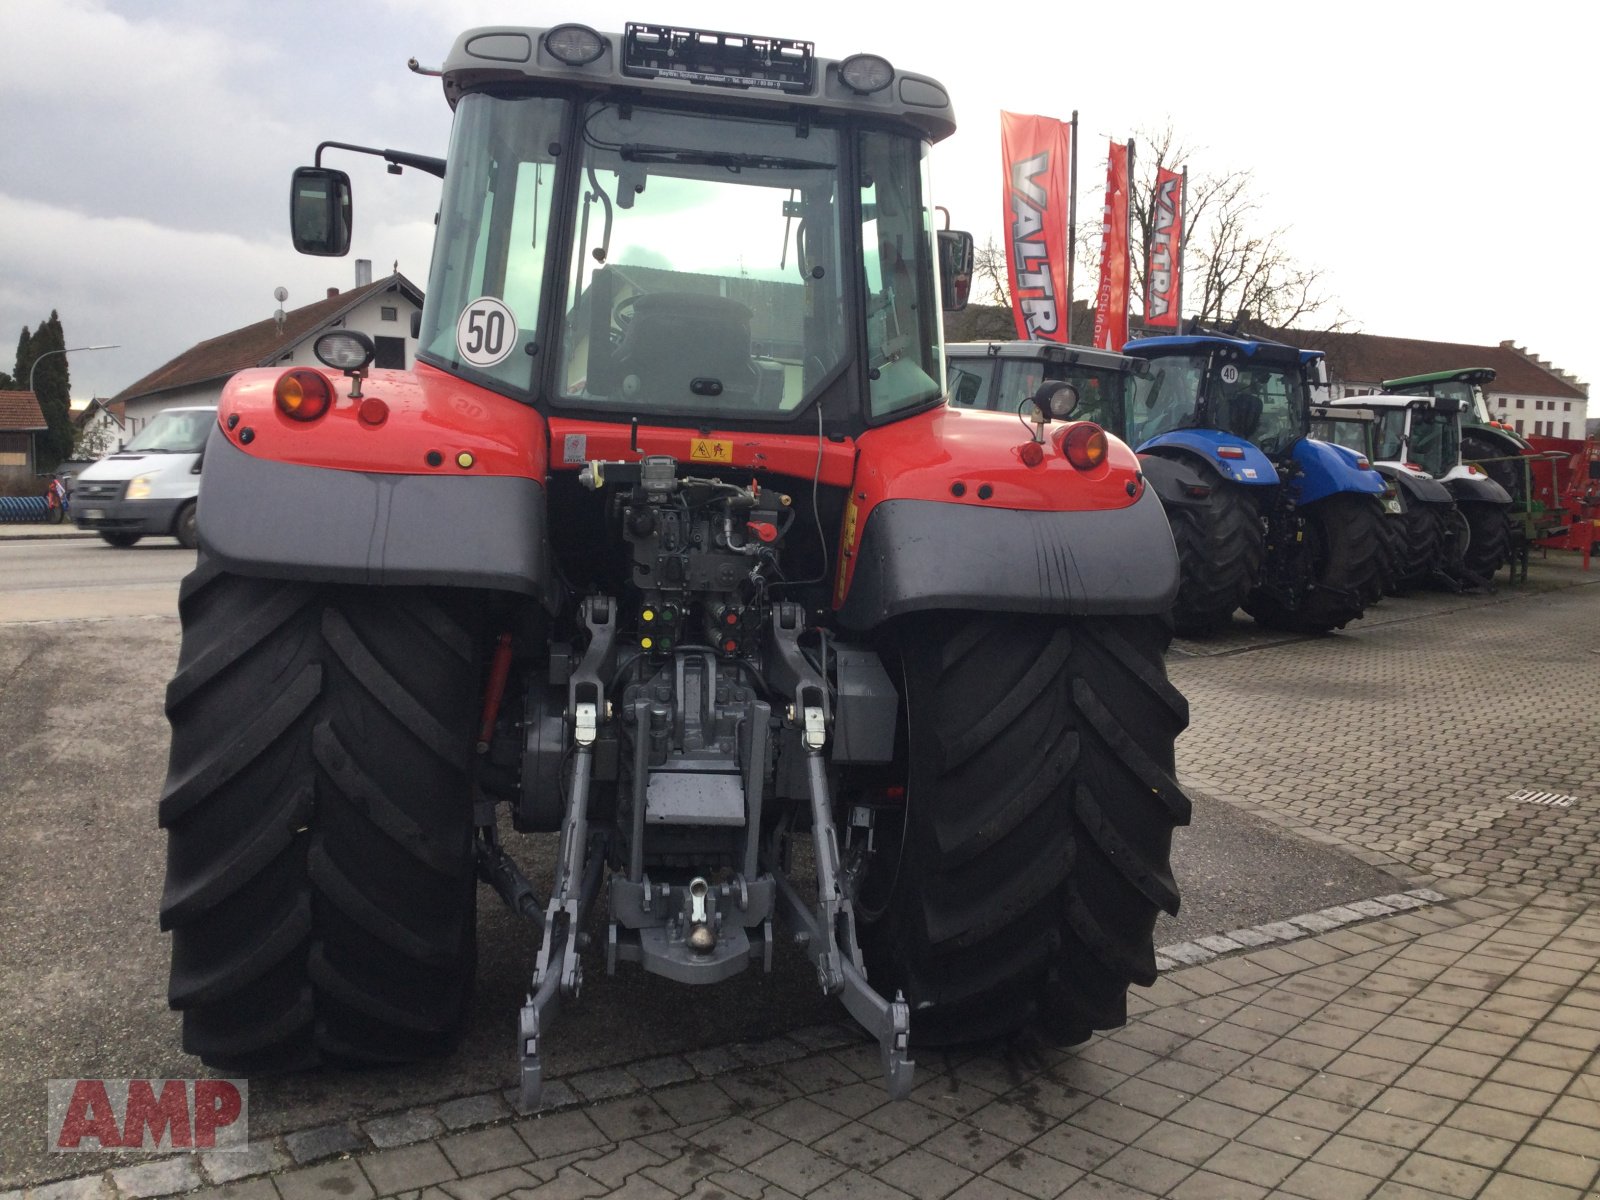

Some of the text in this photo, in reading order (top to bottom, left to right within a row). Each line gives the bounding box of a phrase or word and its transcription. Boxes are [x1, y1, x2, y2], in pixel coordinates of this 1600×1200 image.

[1149, 178, 1177, 319] VALTRA
[466, 309, 505, 355] 50
[1224, 368, 1235, 380] 40
